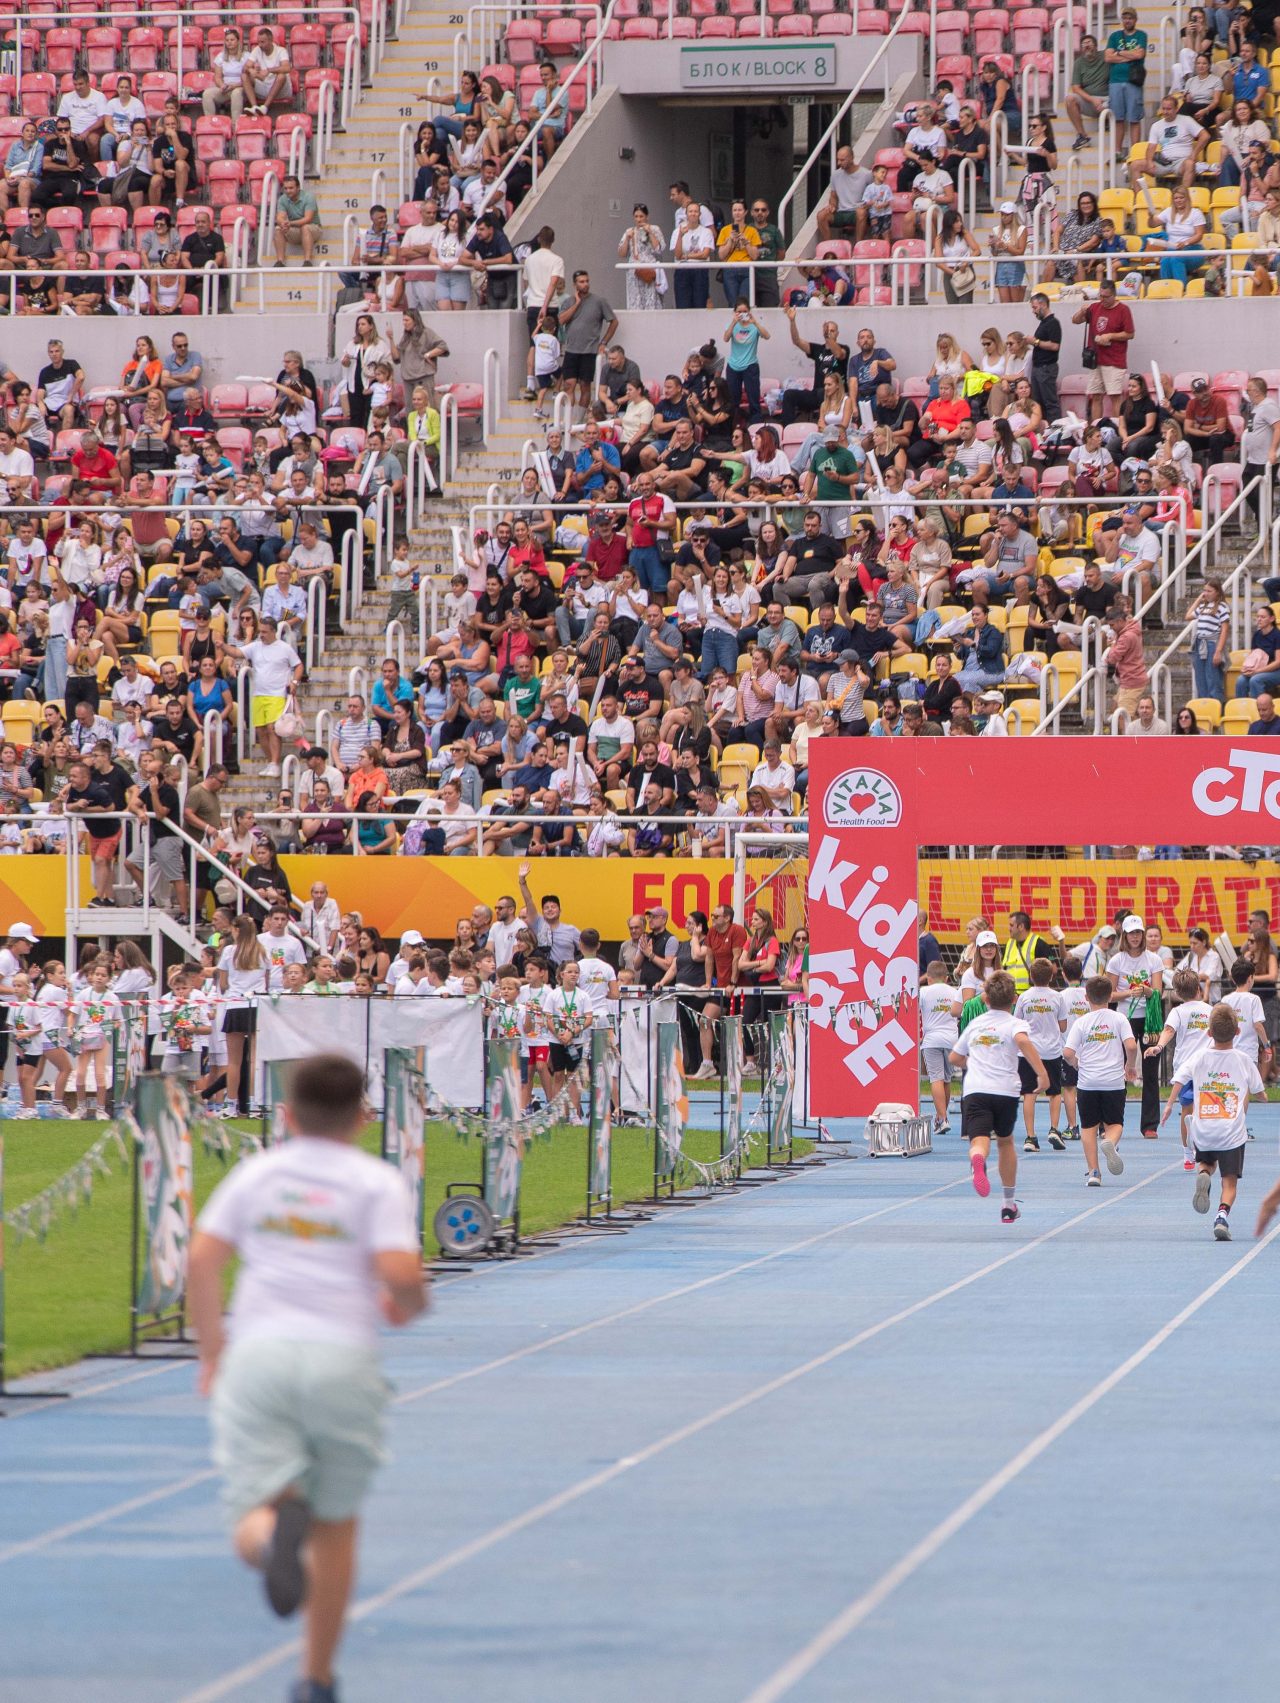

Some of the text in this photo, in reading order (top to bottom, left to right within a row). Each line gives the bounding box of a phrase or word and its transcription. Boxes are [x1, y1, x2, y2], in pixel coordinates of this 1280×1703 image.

[448, 14, 464, 25] 20
[424, 61, 439, 71] 19
[814, 57, 827, 77] 8
[398, 107, 413, 117] 18
[371, 152, 386, 162] 17
[344, 199, 359, 209] 16
[315, 245, 329, 254] 15
[287, 290, 302, 300] 14
[498, 470, 512, 480] 10
[434, 563, 442, 574] 8
[334, 701, 342, 711] 5
[832, 774, 893, 815] VITALIA
[839, 818, 886, 826] Health Food
[1201, 1105, 1220, 1114] 558
